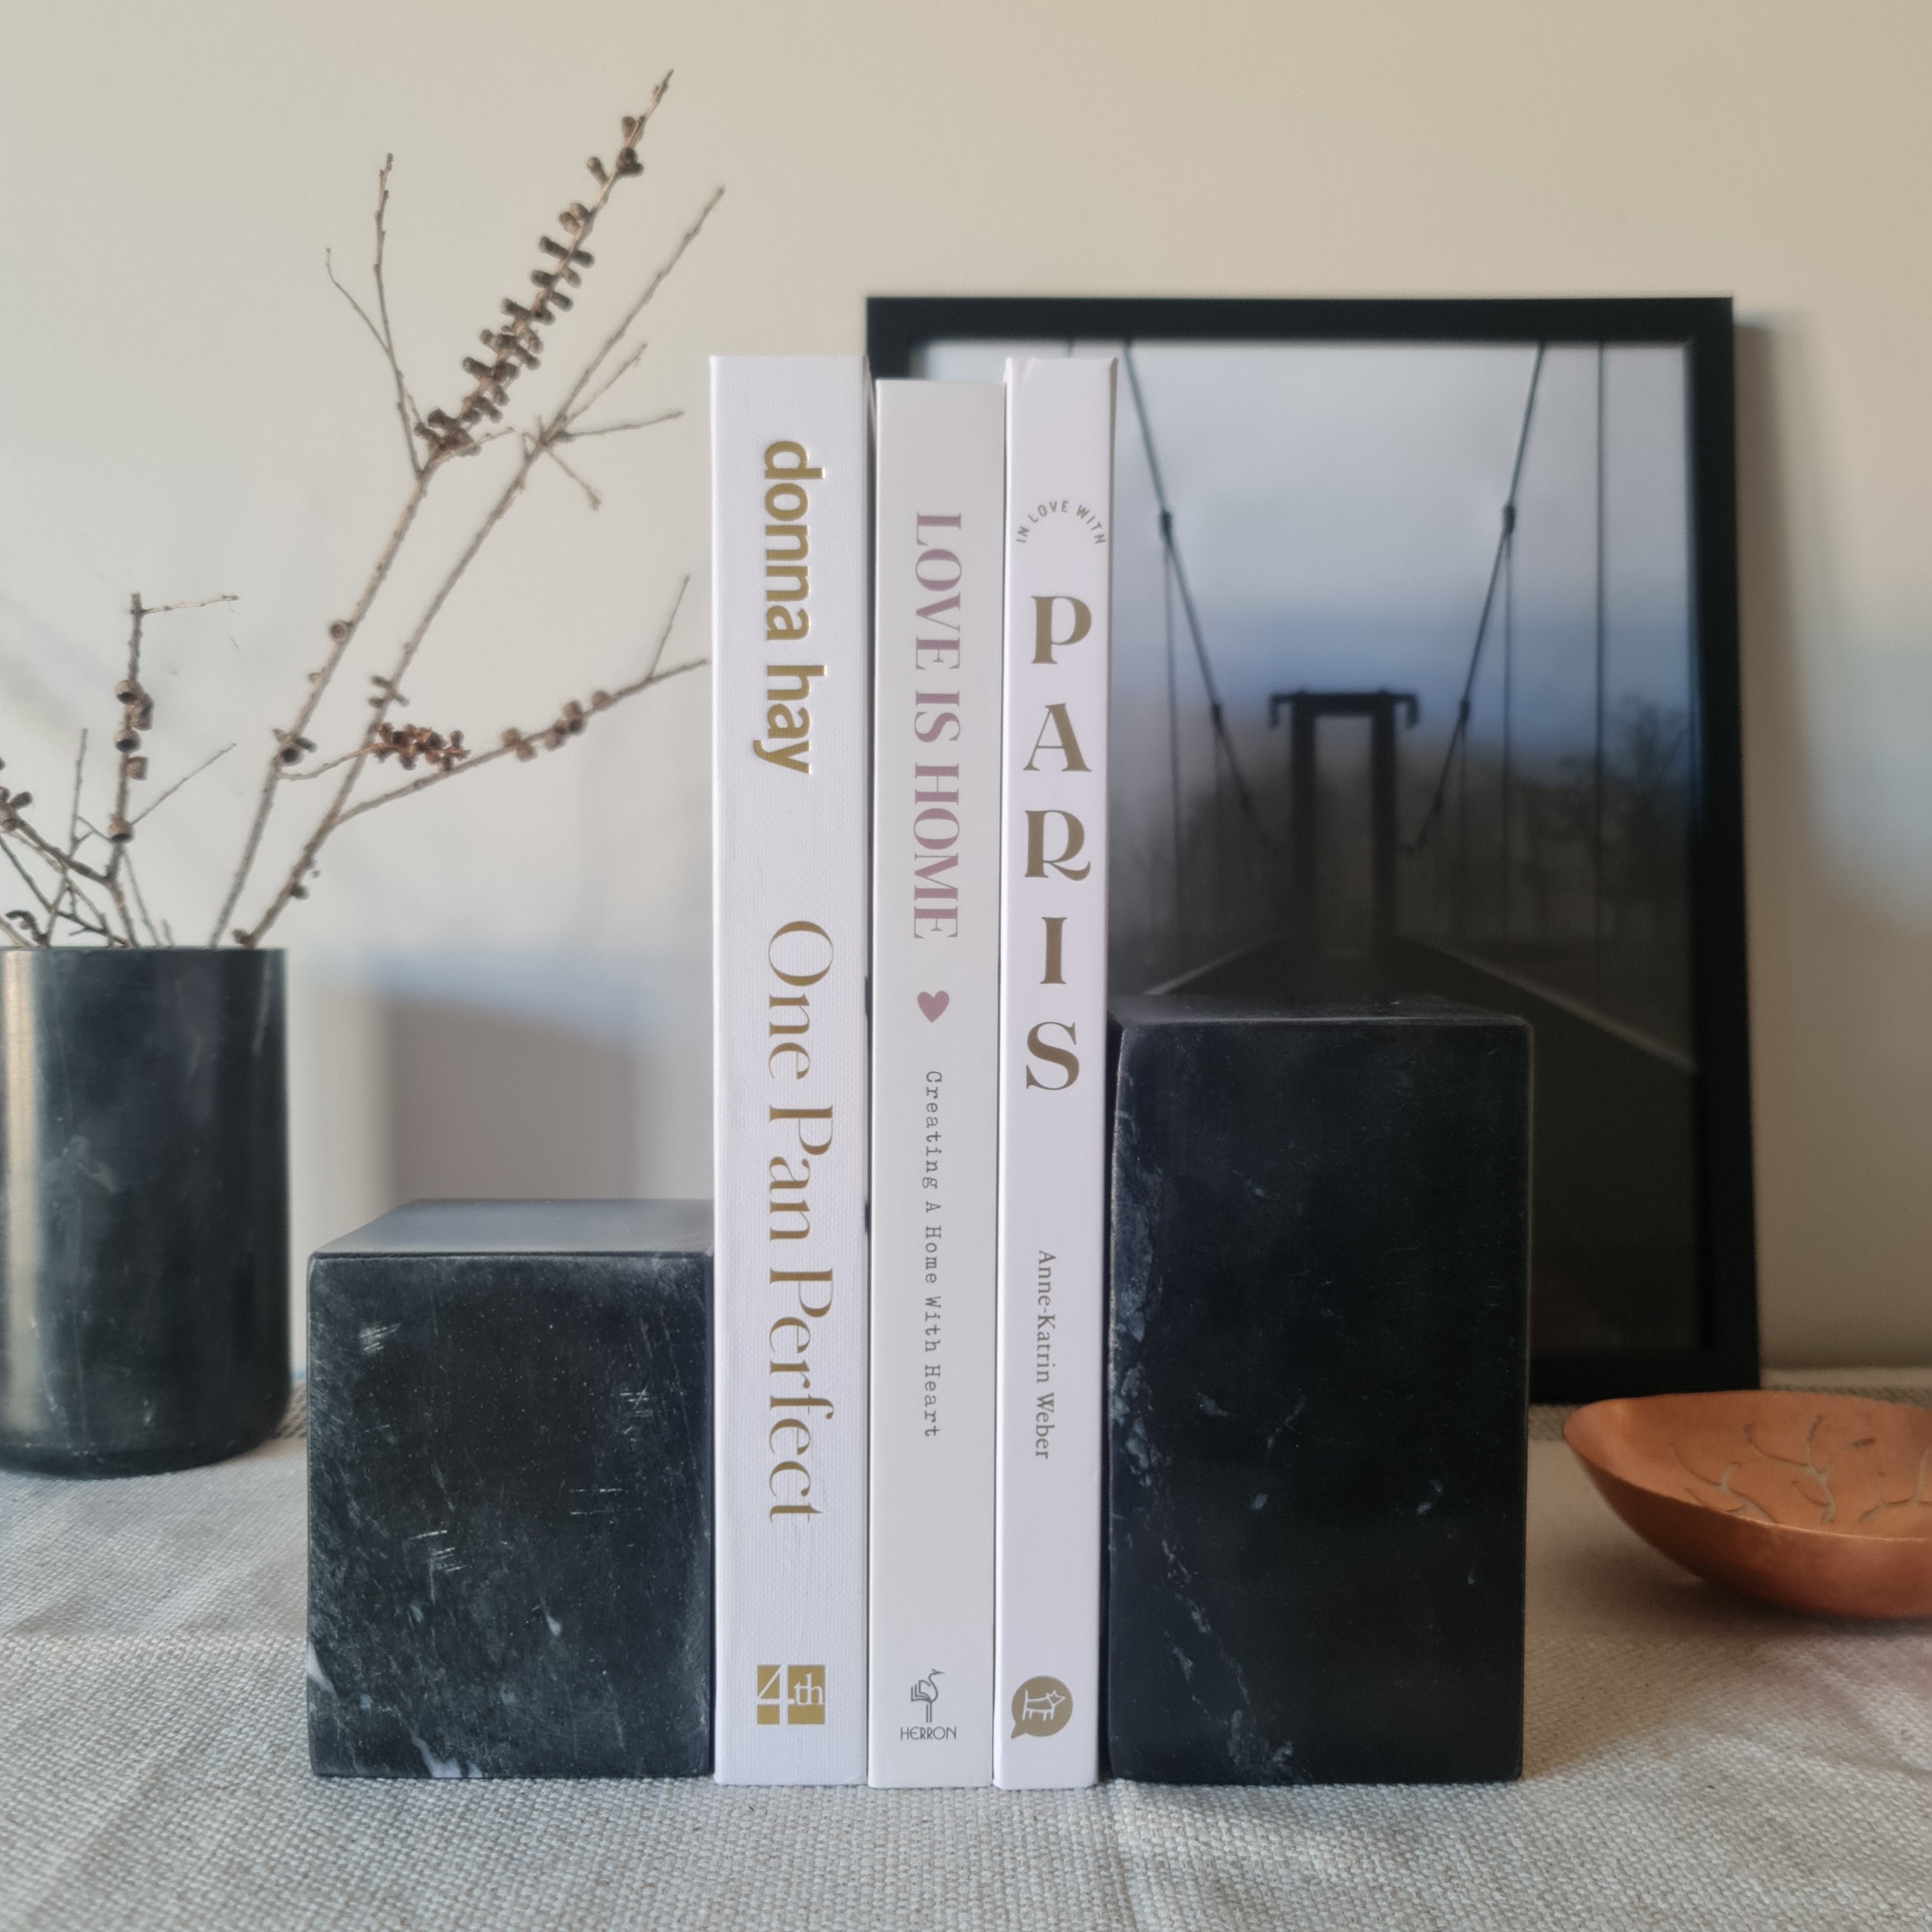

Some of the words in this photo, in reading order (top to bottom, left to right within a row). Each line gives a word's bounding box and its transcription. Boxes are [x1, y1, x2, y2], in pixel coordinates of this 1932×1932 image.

[764, 440, 825, 641] donna
[1016, 526, 1030, 543] IN
[1028, 500, 1069, 524] LOVE
[1076, 503, 1106, 544] WITH
[916, 513, 961, 670] LOVE
[752, 664, 827, 774] hay
[914, 691, 960, 743] IS
[914, 763, 960, 938] HOME
[1023, 595, 1092, 1091] PARIS
[768, 920, 834, 1080] One
[769, 1105, 834, 1241] Pan
[922, 1071, 942, 1189] Creating
[925, 1226, 941, 1283] Home
[926, 1201, 941, 1213] A
[925, 1296, 941, 1352] With
[1036, 1251, 1056, 1382] Anne-Katrin
[769, 1268, 834, 1523] Perfect
[924, 1364, 940, 1437] Heart
[1036, 1392, 1055, 1459] Weber
[757, 1665, 825, 1725] 4th
[900, 1726, 957, 1740] HERRON
